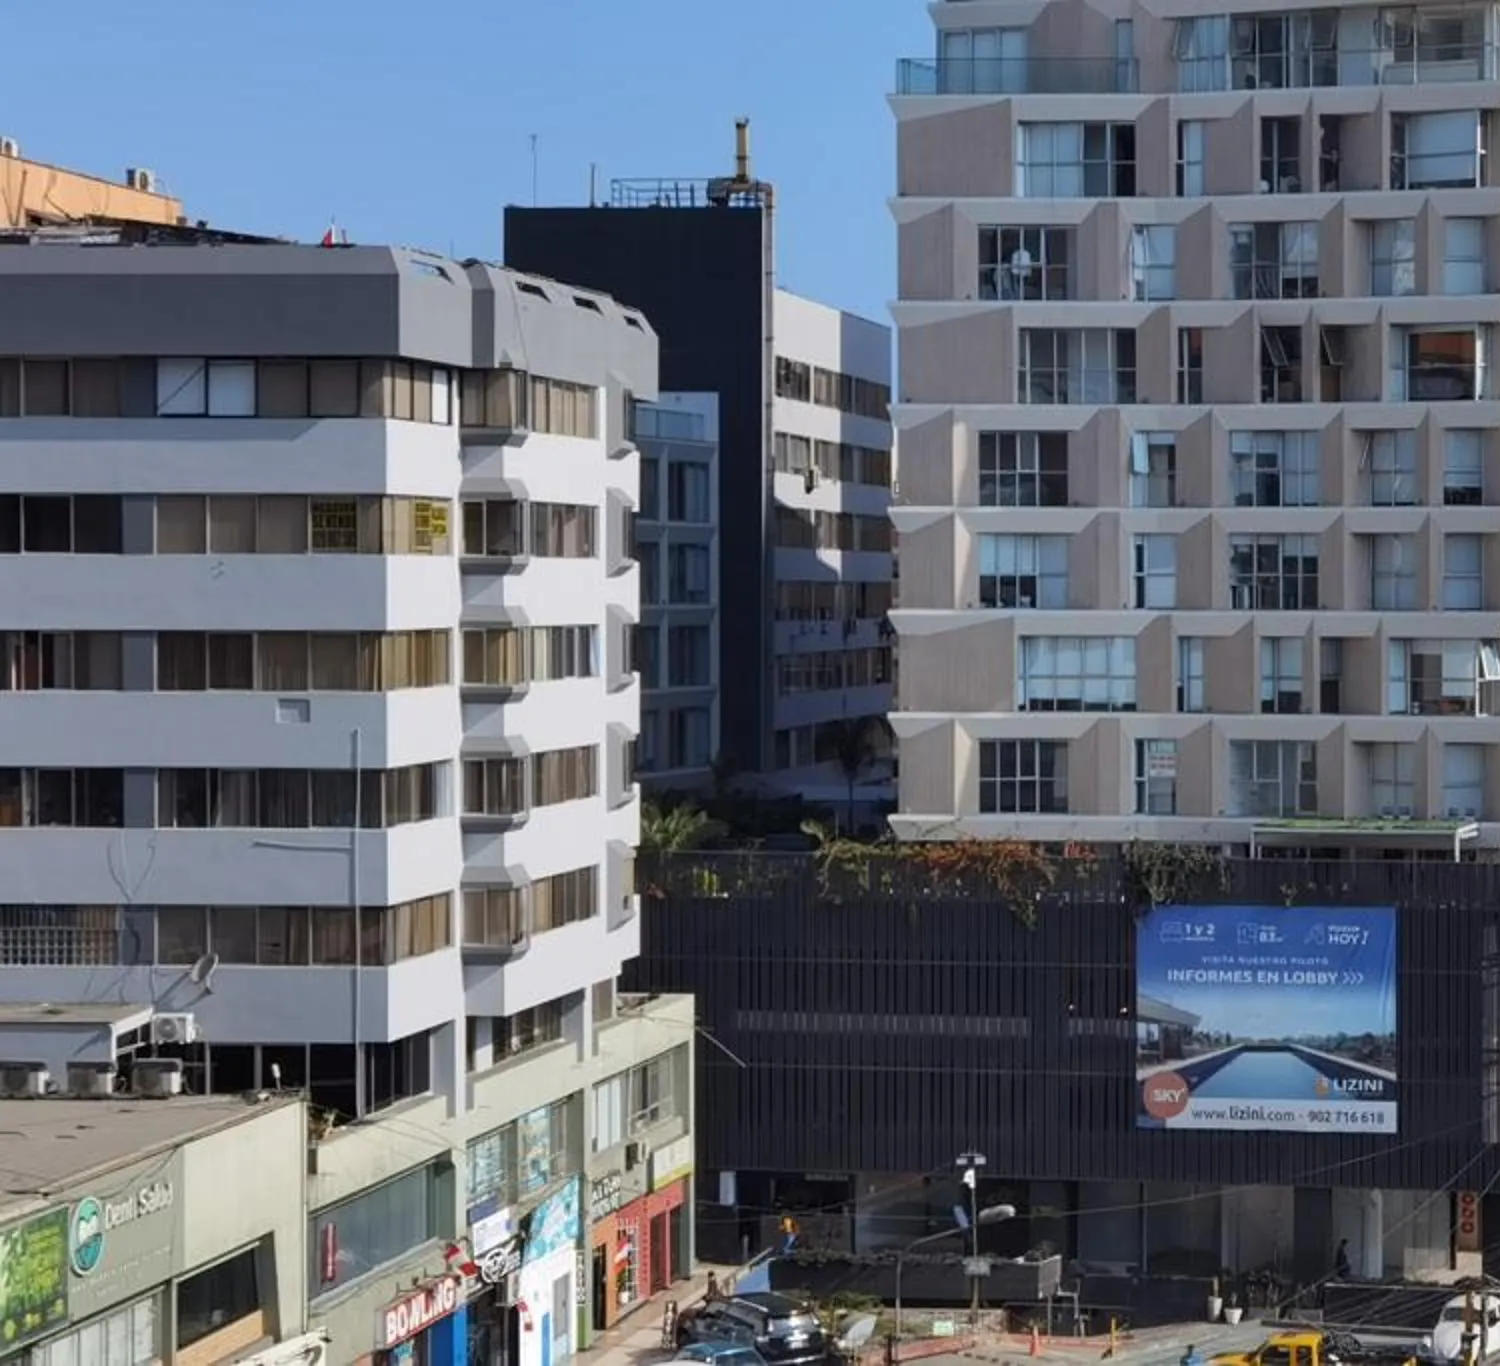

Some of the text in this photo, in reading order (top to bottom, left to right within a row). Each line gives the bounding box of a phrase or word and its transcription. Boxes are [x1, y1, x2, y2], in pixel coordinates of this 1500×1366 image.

[1201, 955, 1329, 966] VISITA NUESTRO PILOTO
[1167, 968, 1338, 985] INFORMES EN LOBBY
[1332, 1078, 1383, 1092] LIZINI
[1192, 1106, 1295, 1122] www.lizini.com
[386, 1278, 457, 1345] BOWLING
